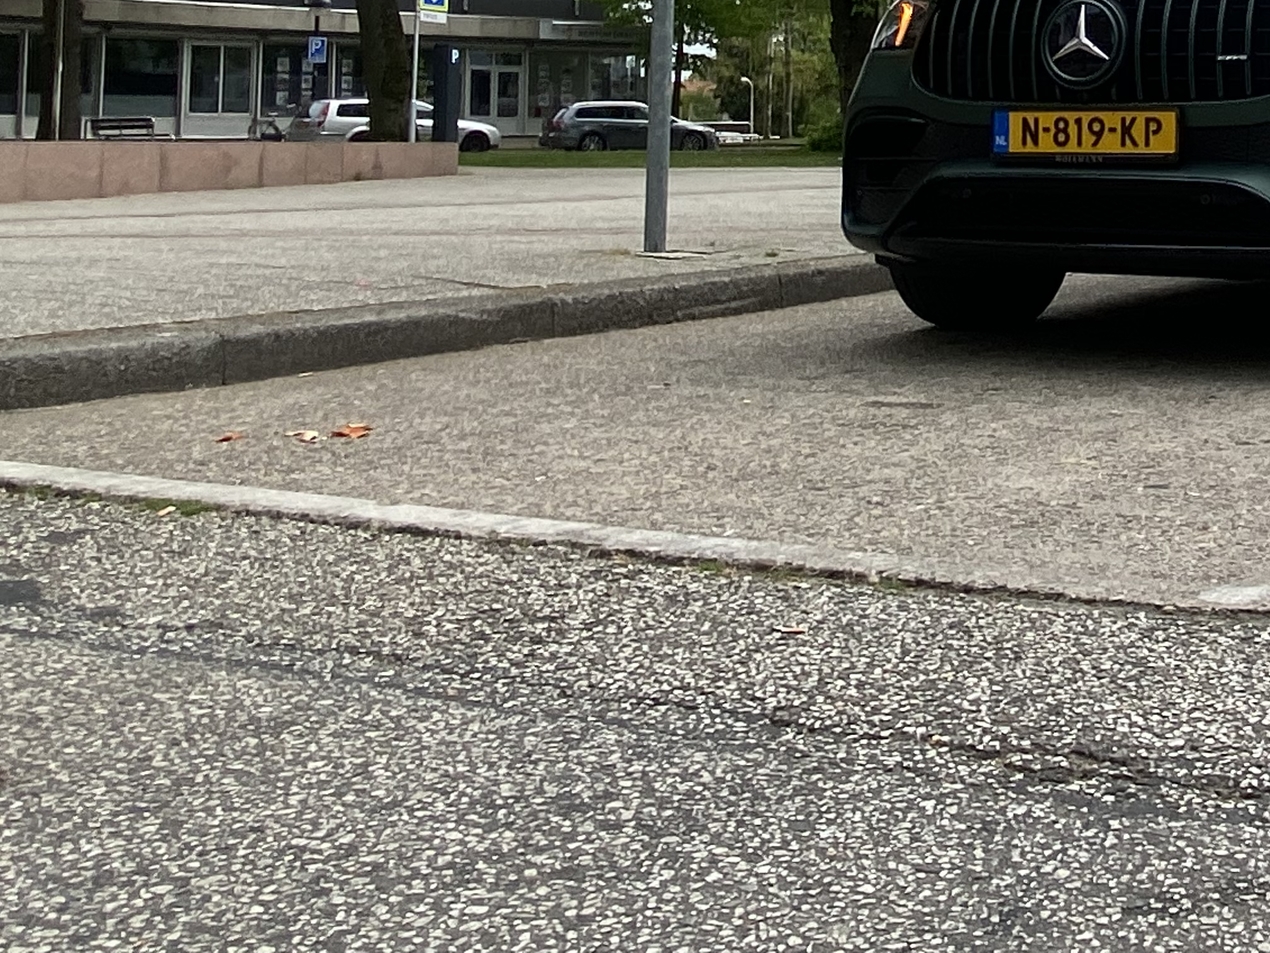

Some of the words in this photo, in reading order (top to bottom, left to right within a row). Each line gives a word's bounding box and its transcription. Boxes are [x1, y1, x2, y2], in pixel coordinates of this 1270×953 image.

[311, 38, 322, 54] P
[451, 49, 460, 64] P
[1021, 116, 1163, 148] N-819-KP
[995, 135, 1007, 146] NL
